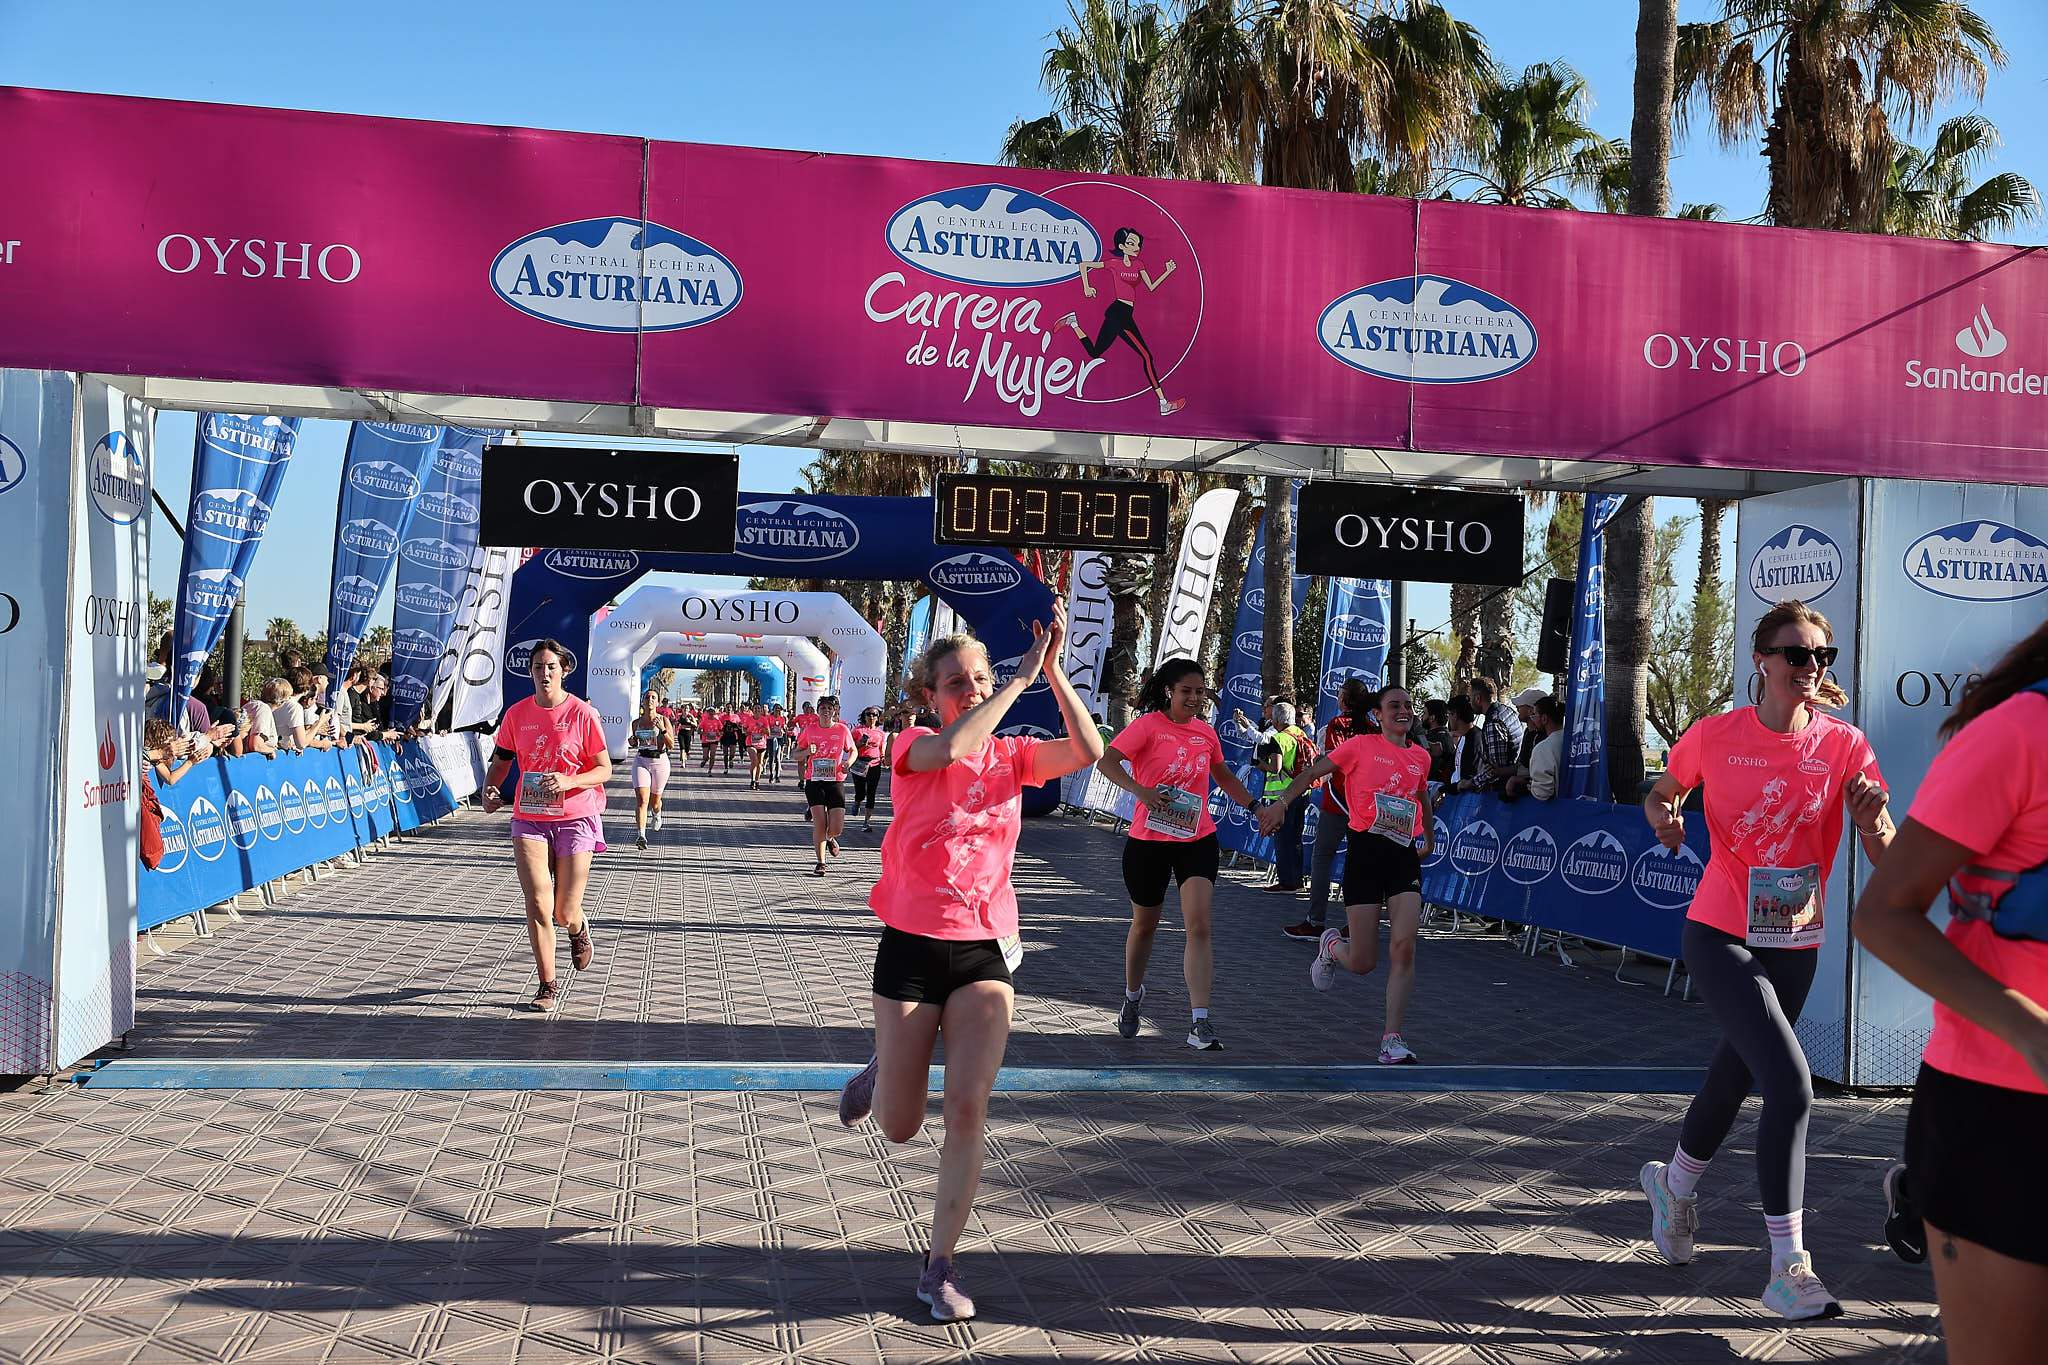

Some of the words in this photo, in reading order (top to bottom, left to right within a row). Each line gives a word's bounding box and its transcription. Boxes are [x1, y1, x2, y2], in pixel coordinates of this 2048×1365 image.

[937, 215, 1005, 230] CENTRAL
[1011, 221, 1079, 236] LECHERA
[901, 215, 1083, 265] ASTURIANA
[156, 233, 361, 283] OYSHO
[550, 253, 630, 268] CENTRAL
[509, 253, 723, 307] ASTURIANA
[864, 271, 1042, 335] Carrera
[1369, 309, 1438, 323] CENTRAL
[1445, 313, 1514, 328] LECHERA
[1333, 309, 1520, 360] ASTURIANA
[1643, 333, 1807, 377] OYSHO
[905, 329, 940, 366] de
[946, 330, 970, 369] la
[963, 331, 1106, 417] Mujer
[352, 468, 414, 496] ASTURIANA
[416, 497, 474, 522] ASTURIANA
[523, 479, 702, 522] OYSHO
[952, 485, 1151, 541] 00:37:26
[745, 517, 793, 526] CENTRAL
[796, 519, 844, 528] LECHERA
[1334, 514, 1493, 555] OYSHO
[404, 547, 463, 567] ASTURIANA
[549, 551, 632, 570] ASTURIANA
[1768, 550, 1798, 563] CENTRAL
[1799, 548, 1832, 560] LECHERA
[1914, 547, 2048, 584] ASTURIANA
[1938, 547, 1990, 557] CENTRAL
[1993, 548, 2045, 559] LECHERA
[937, 568, 1015, 585] ASTURIANA
[1755, 558, 1835, 589] ASTURIANA
[396, 589, 452, 611] ASTURIANA
[681, 596, 800, 624] OYSHO
[84, 594, 141, 640] OYSHO
[609, 619, 647, 631] OYSHO
[831, 626, 867, 637] OYSHO
[1330, 628, 1386, 643] ASTURIANA
[591, 667, 626, 677] OYSHO
[848, 675, 881, 686] OYSHO
[1727, 755, 1768, 767] OYSHO
[83, 779, 131, 809] Santander
[1452, 837, 1496, 864] ASTURIANA
[1504, 845, 1552, 872] ASTURIANA
[1564, 851, 1622, 882] ASTURIANA
[1635, 860, 1698, 896] ASTURIANA
